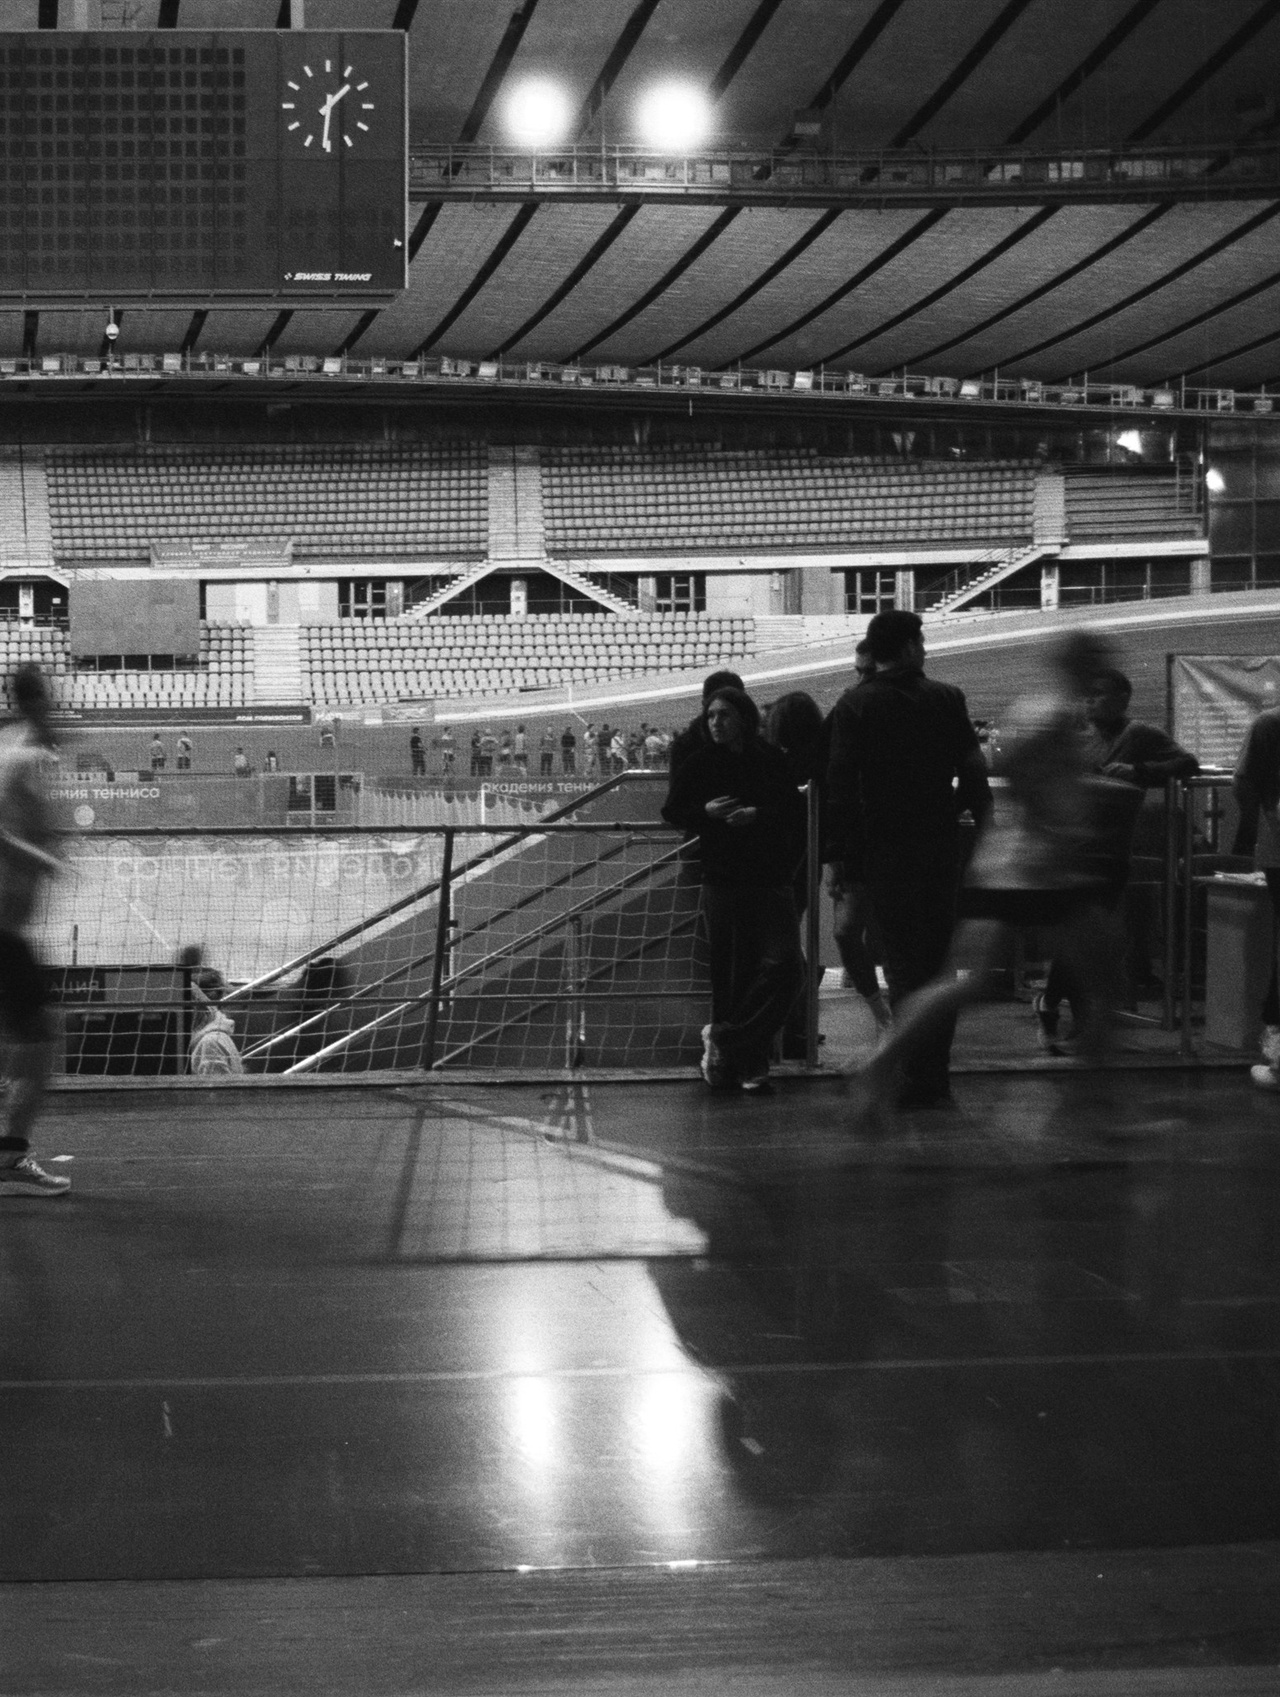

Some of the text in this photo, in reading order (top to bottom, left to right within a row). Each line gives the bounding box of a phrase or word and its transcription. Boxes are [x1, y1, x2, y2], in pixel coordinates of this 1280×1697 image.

[294, 272, 372, 281] SWISS TIMING
[92, 787, 160, 799] тенниса
